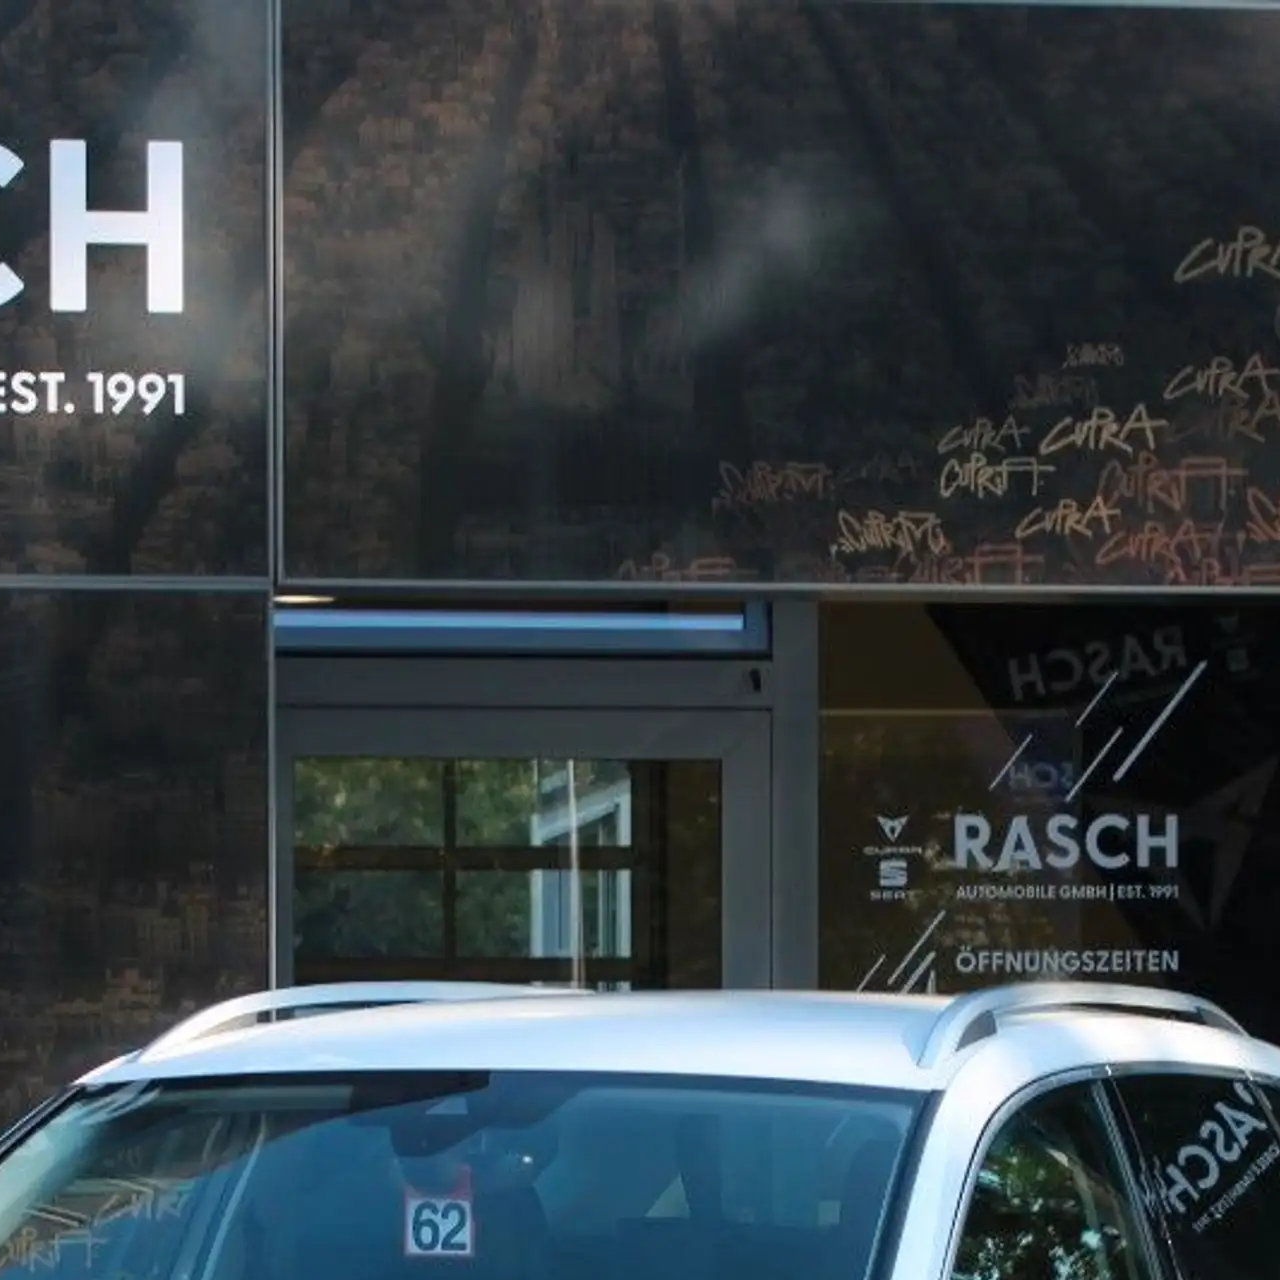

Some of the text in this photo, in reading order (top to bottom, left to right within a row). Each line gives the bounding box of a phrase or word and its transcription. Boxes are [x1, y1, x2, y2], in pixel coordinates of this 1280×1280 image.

[87, 371, 186, 415] 1991
[1163, 353, 1280, 400] CUPRA
[937, 414, 1030, 454] CUPRA
[1039, 402, 1170, 454] CUPRA
[1015, 494, 1121, 540] CUPRA
[954, 813, 1179, 871] RASCH
[956, 884, 1055, 900] AUTOMOBILE
[1059, 885, 1107, 899] GMBH
[1150, 885, 1179, 899] 1991
[955, 945, 1179, 973] ÖFFNUNGSZEITEN
[412, 1200, 468, 1252] 62
